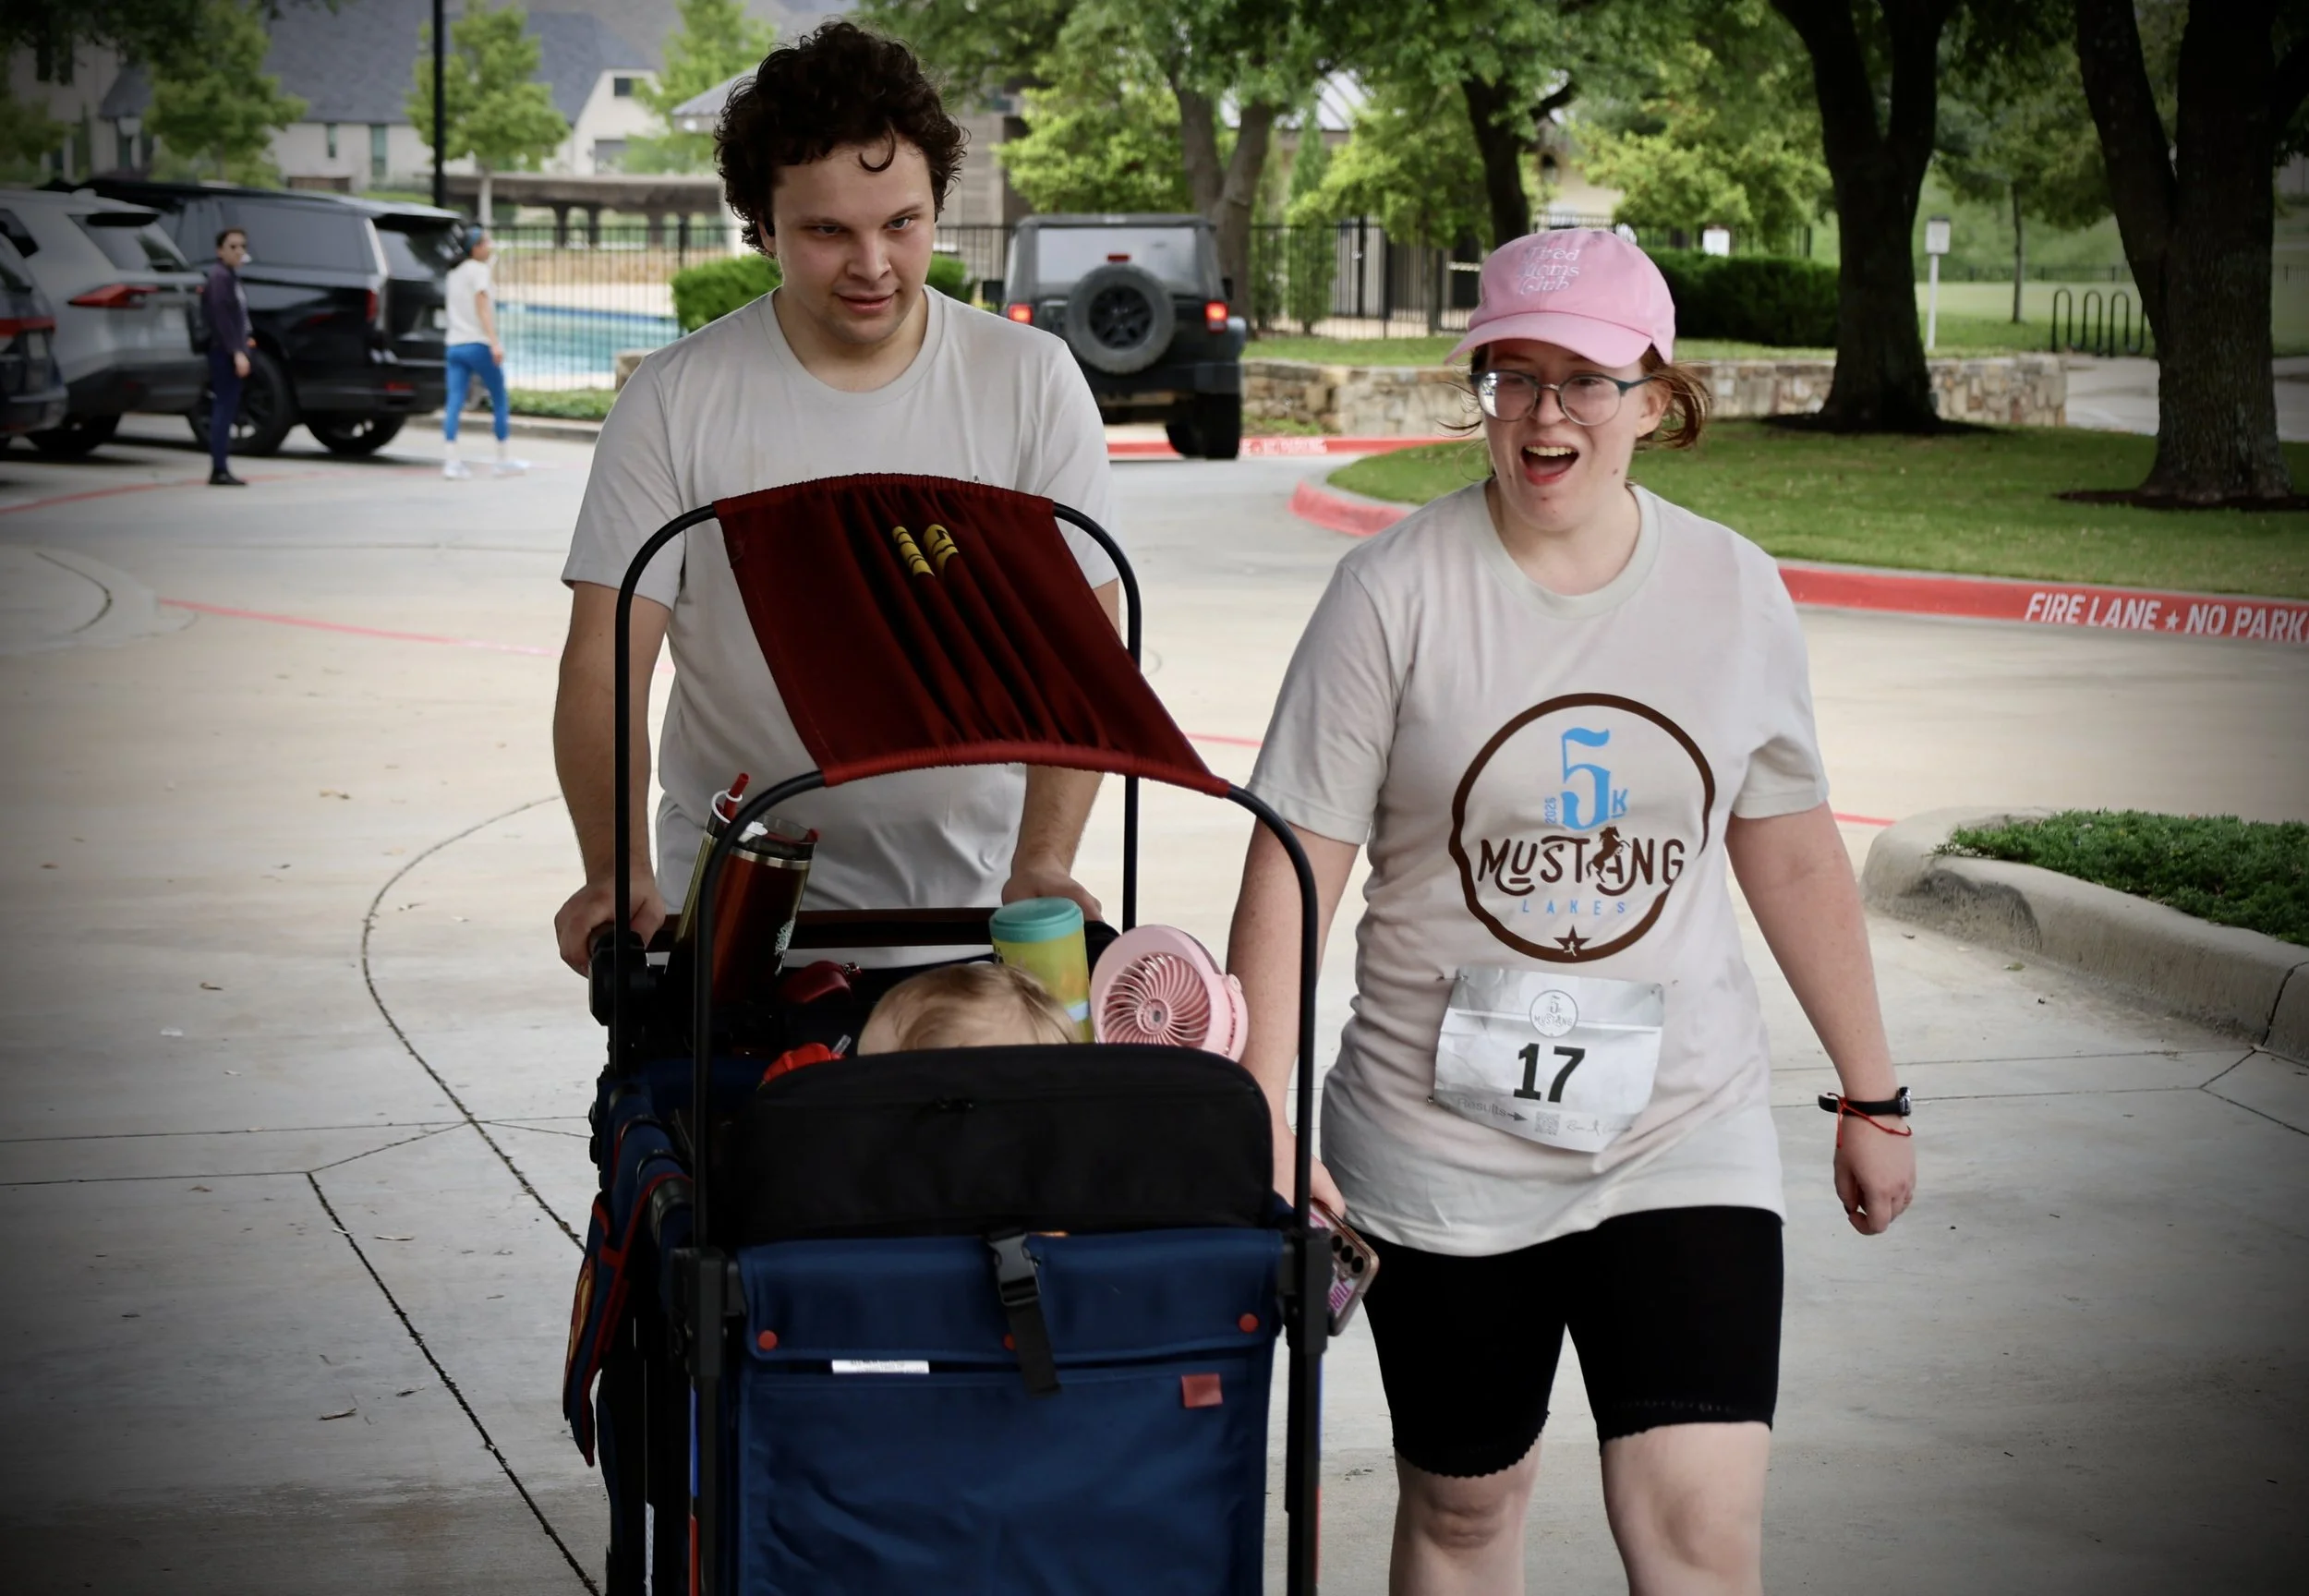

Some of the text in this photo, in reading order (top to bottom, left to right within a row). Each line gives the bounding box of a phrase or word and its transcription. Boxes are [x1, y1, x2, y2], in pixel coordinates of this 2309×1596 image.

[2025, 591, 2309, 644] FIRE LANE NO PARK
[1478, 833, 1686, 896] MUSTANG
[1522, 900, 1626, 915] LAKES
[1513, 1042, 1586, 1104] 17
[1457, 1097, 1507, 1118] Results
